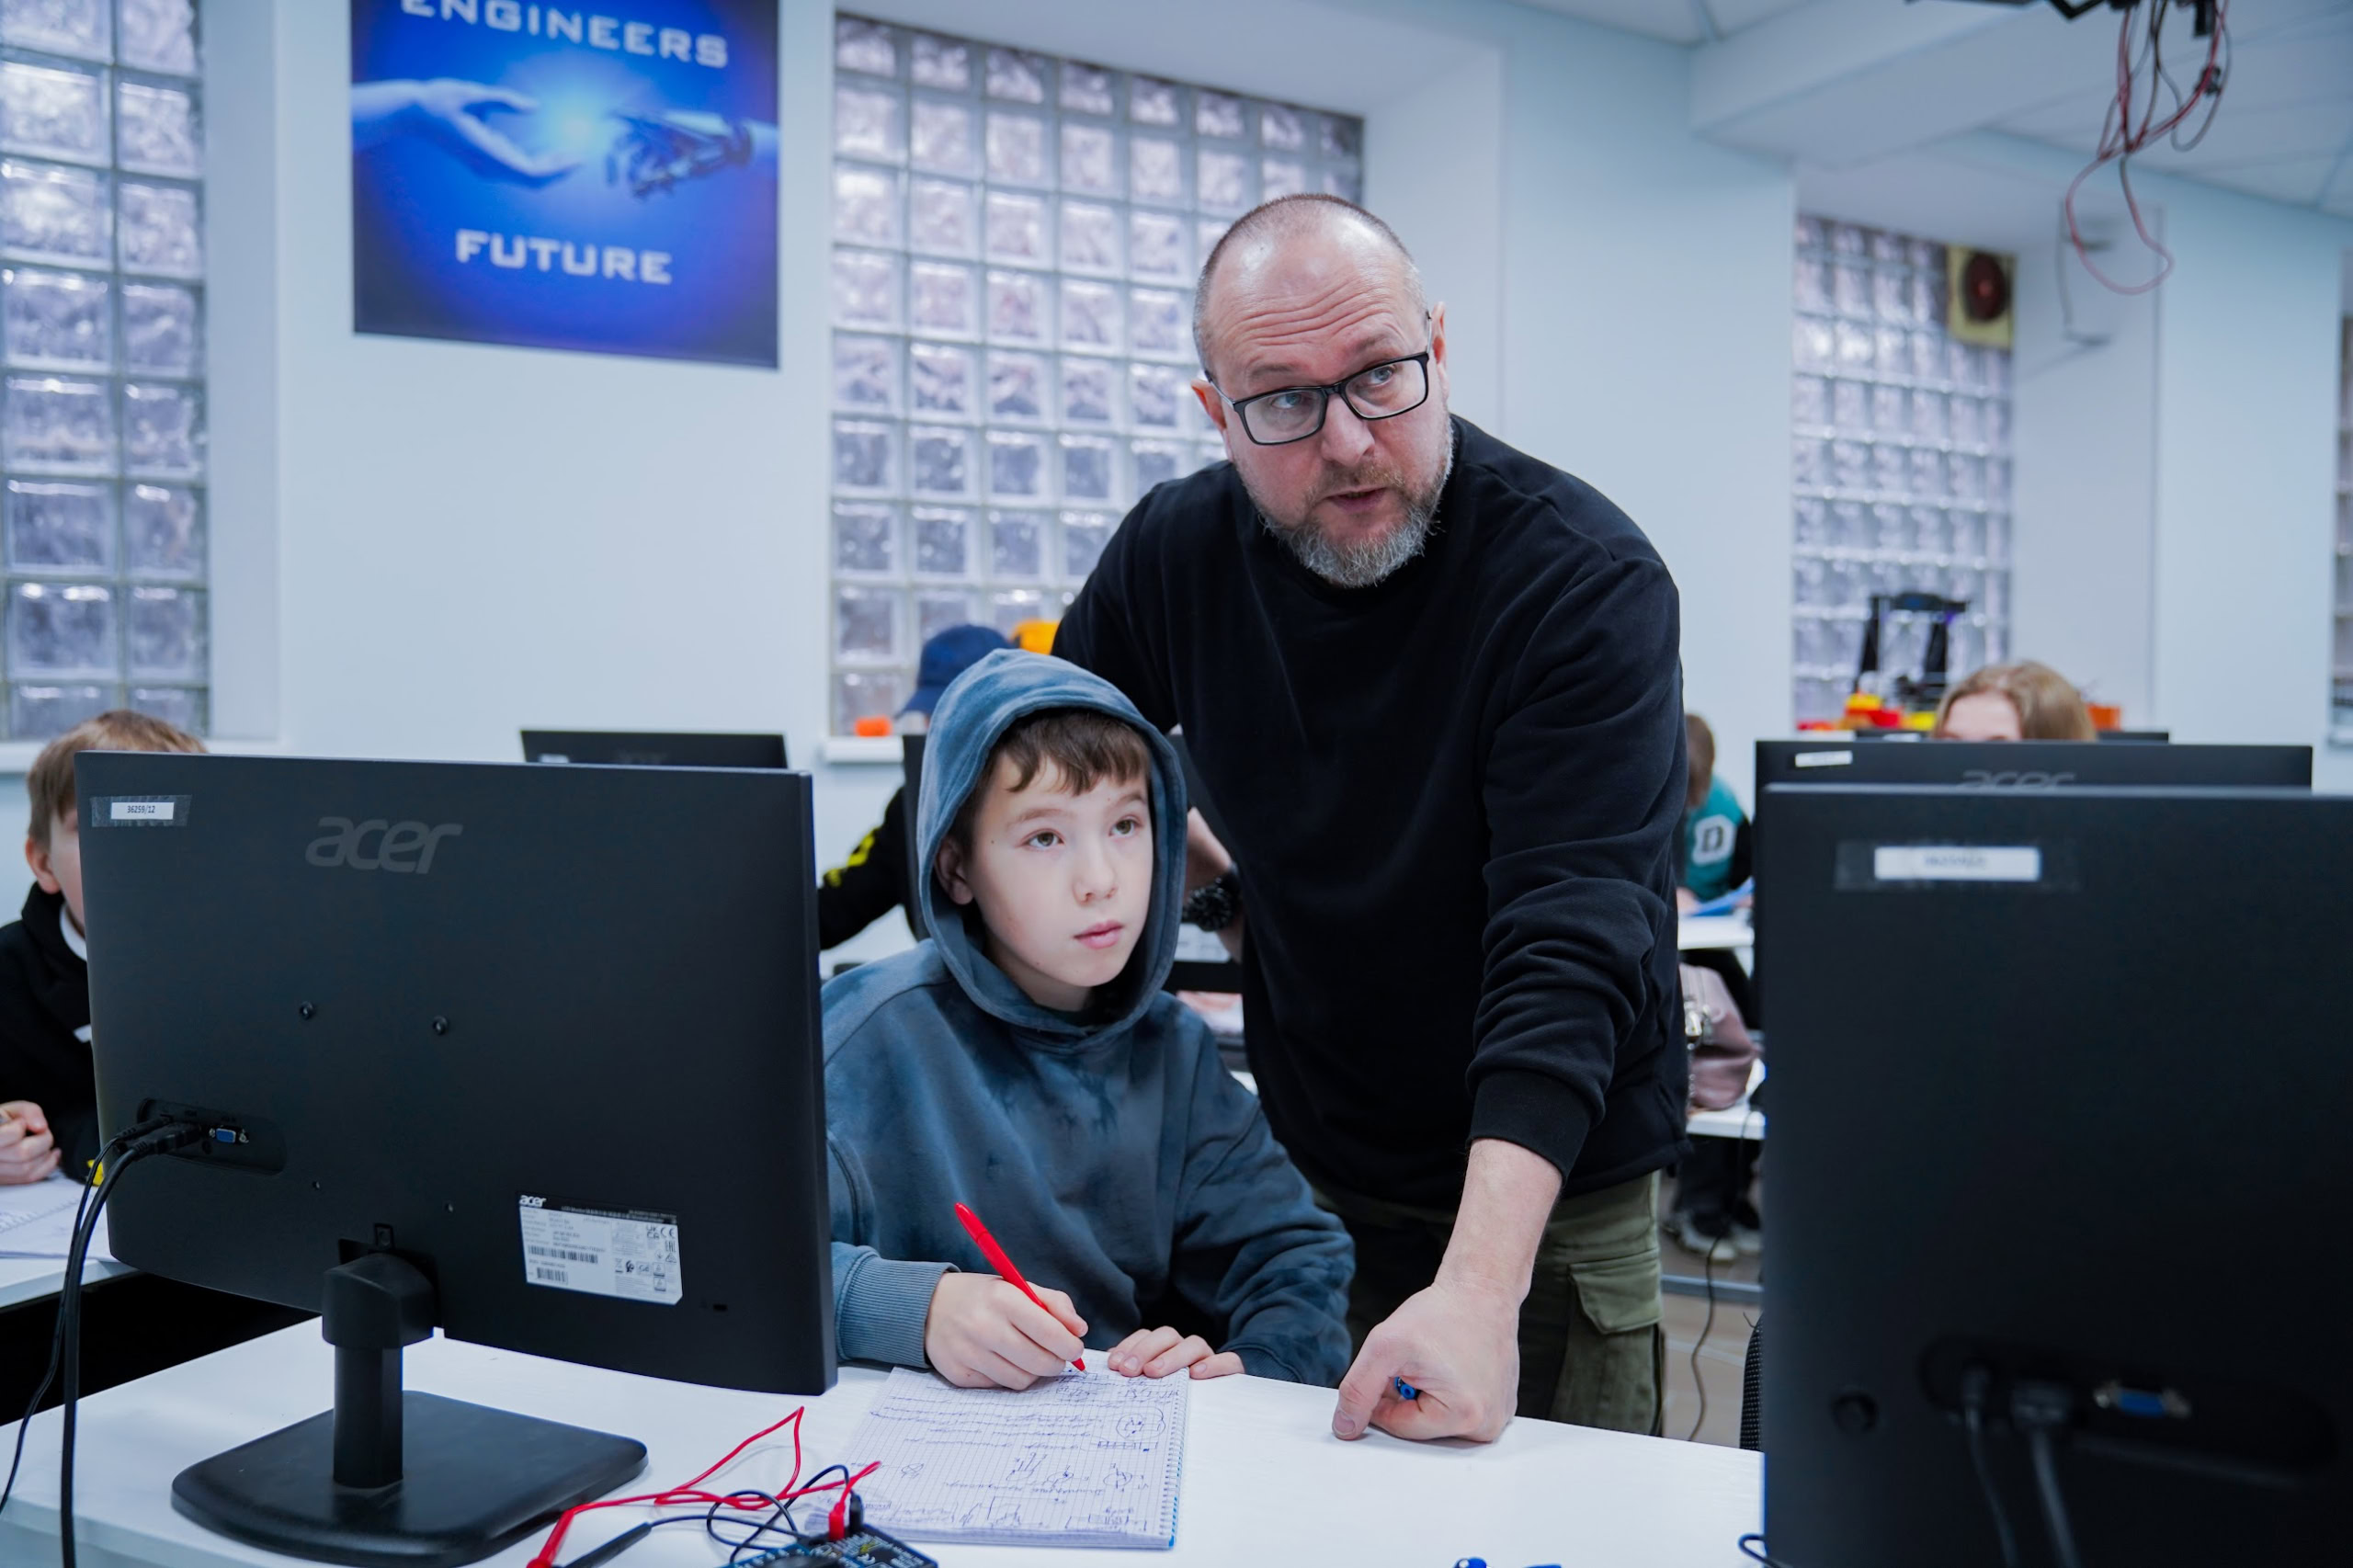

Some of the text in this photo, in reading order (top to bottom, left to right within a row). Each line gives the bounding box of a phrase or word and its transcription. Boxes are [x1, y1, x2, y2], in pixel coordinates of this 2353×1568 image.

[401, 0, 728, 68] ENGINEERS
[456, 228, 672, 285] FUTURE
[127, 805, 155, 814] 36259/12
[306, 816, 462, 874] acer
[519, 1195, 546, 1208] acer
